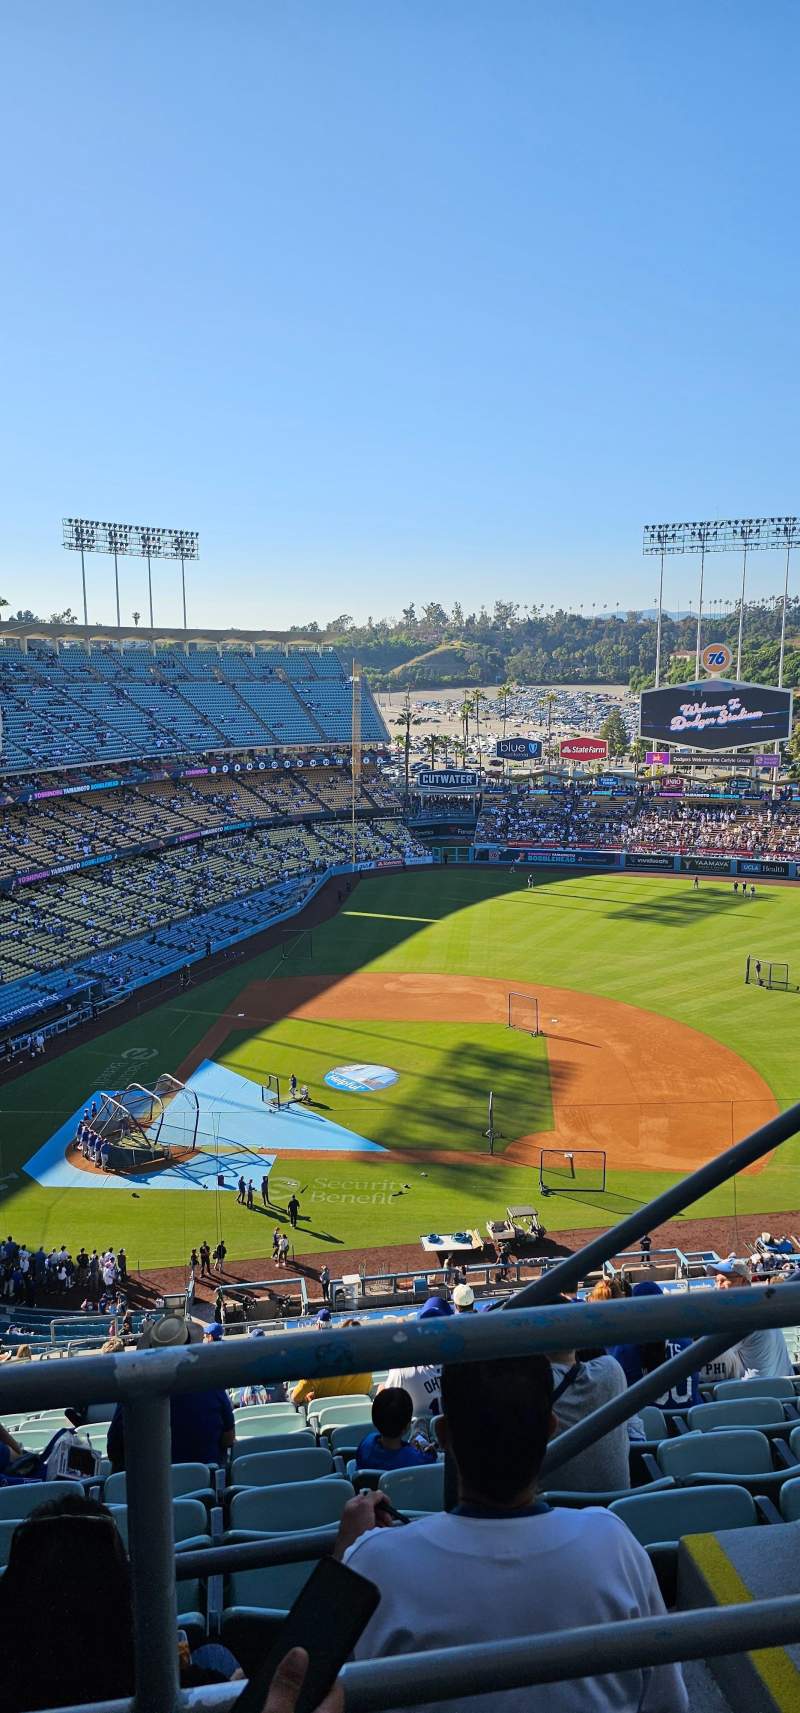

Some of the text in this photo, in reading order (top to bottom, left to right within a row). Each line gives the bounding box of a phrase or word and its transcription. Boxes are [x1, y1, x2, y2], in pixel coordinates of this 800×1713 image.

[708, 651, 726, 665] 76
[680, 697, 742, 716] Welcome To
[670, 707, 763, 731] Dodger Stadium
[500, 742, 526, 753] blue
[422, 774, 475, 785] CUTWATER
[527, 855, 576, 863] BOBBLEHEAD
[50, 862, 81, 875] YAMAMOTO
[743, 863, 785, 873] UCLA Health
[310, 1191, 398, 1205] Benefit
